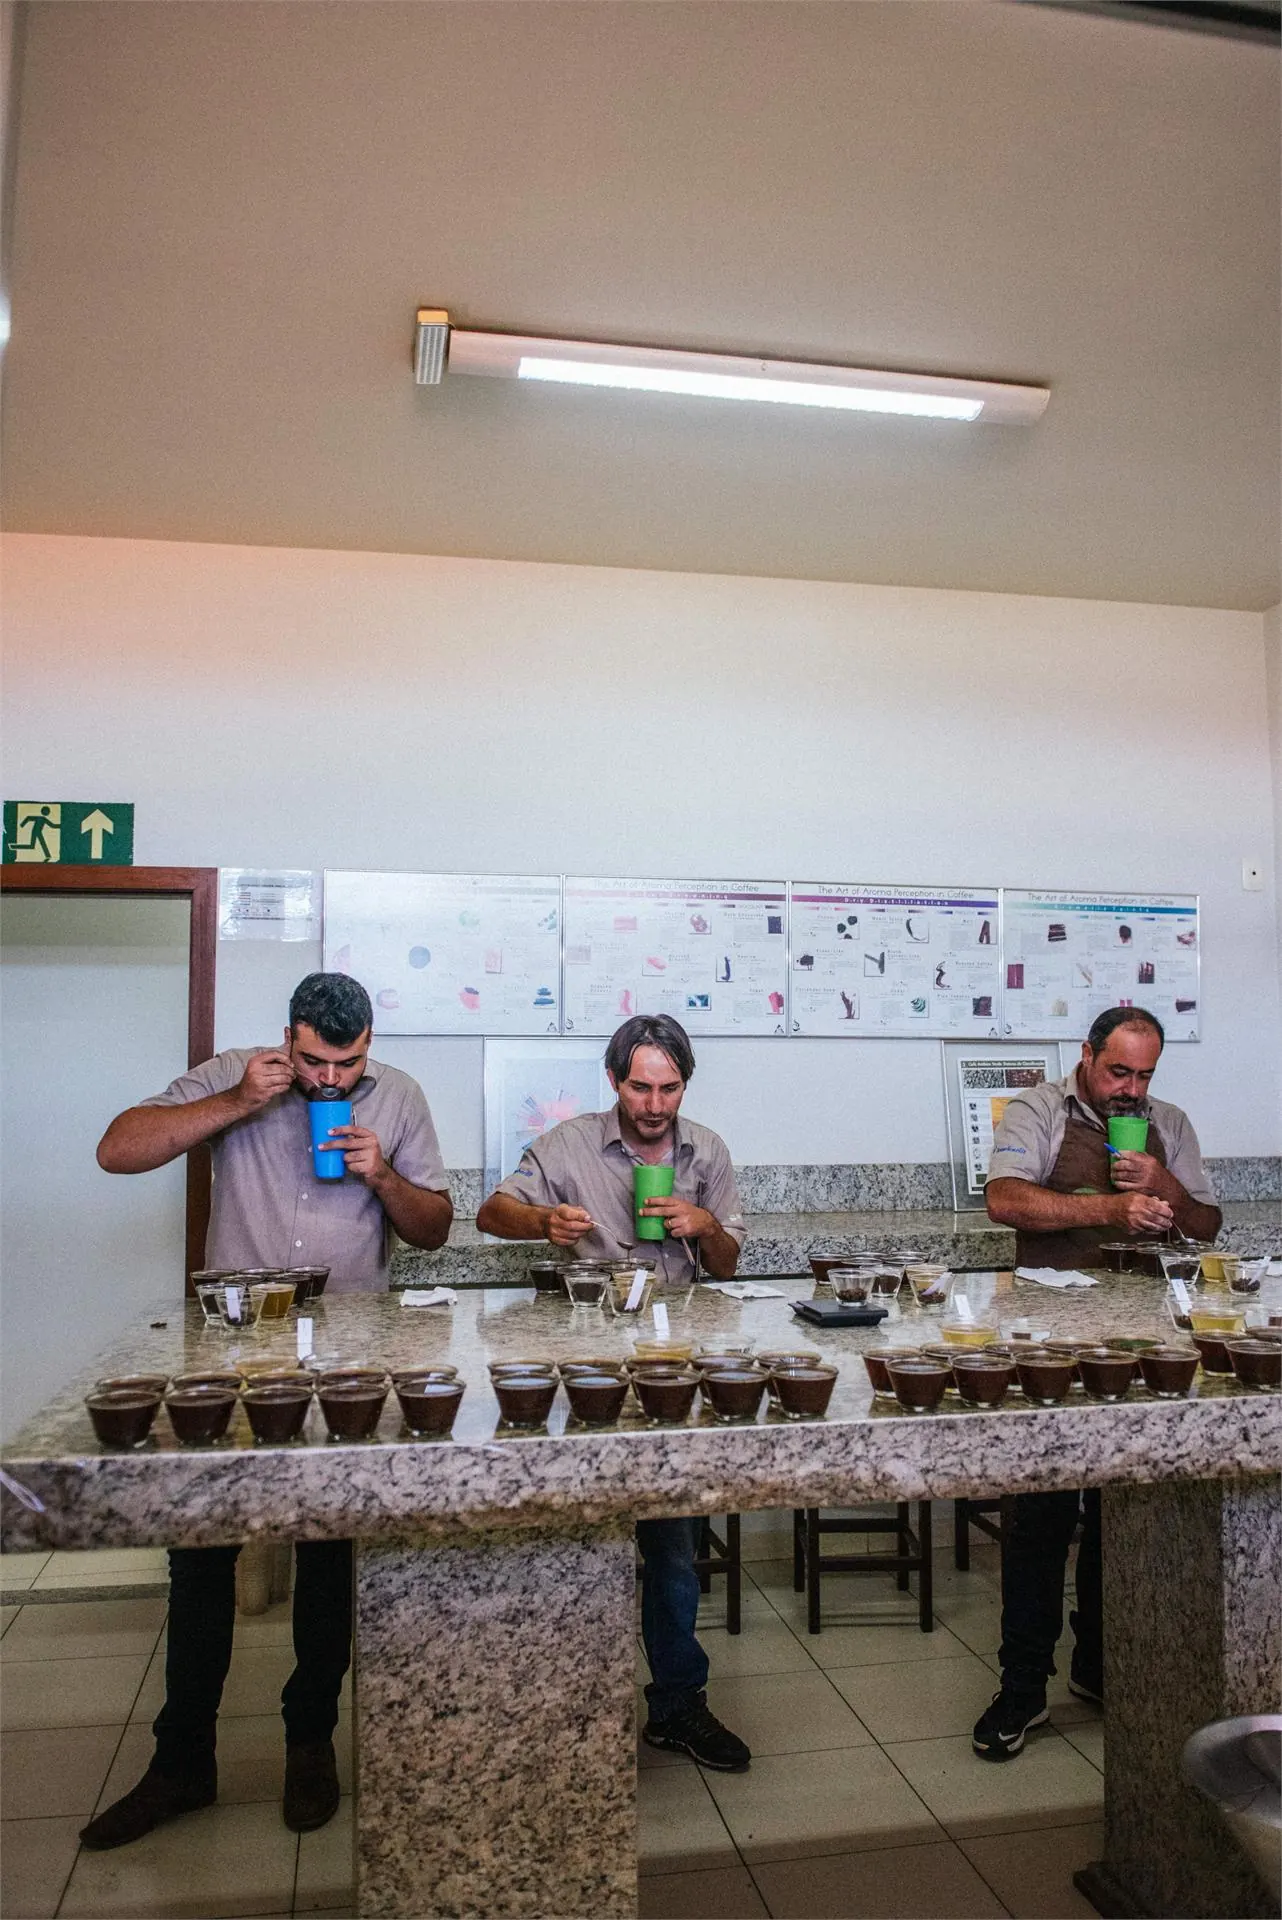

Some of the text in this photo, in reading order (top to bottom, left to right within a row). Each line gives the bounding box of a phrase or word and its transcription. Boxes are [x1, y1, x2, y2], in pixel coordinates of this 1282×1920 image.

[674, 882, 718, 892] Perception
[720, 883, 728, 891] in
[731, 883, 760, 892] Coffee
[818, 886, 832, 894] The
[836, 887, 849, 895] Art
[852, 887, 860, 895] of
[863, 888, 892, 896] Aroma
[894, 888, 935, 898] Perception
[947, 889, 974, 899] Coffee
[1028, 893, 1042, 901] The
[1045, 894, 1057, 902] Art
[1059, 894, 1068, 902] of
[1071, 895, 1097, 903] Aroma
[1099, 896, 1137, 905] Perception
[1149, 897, 1175, 906] Coffee
